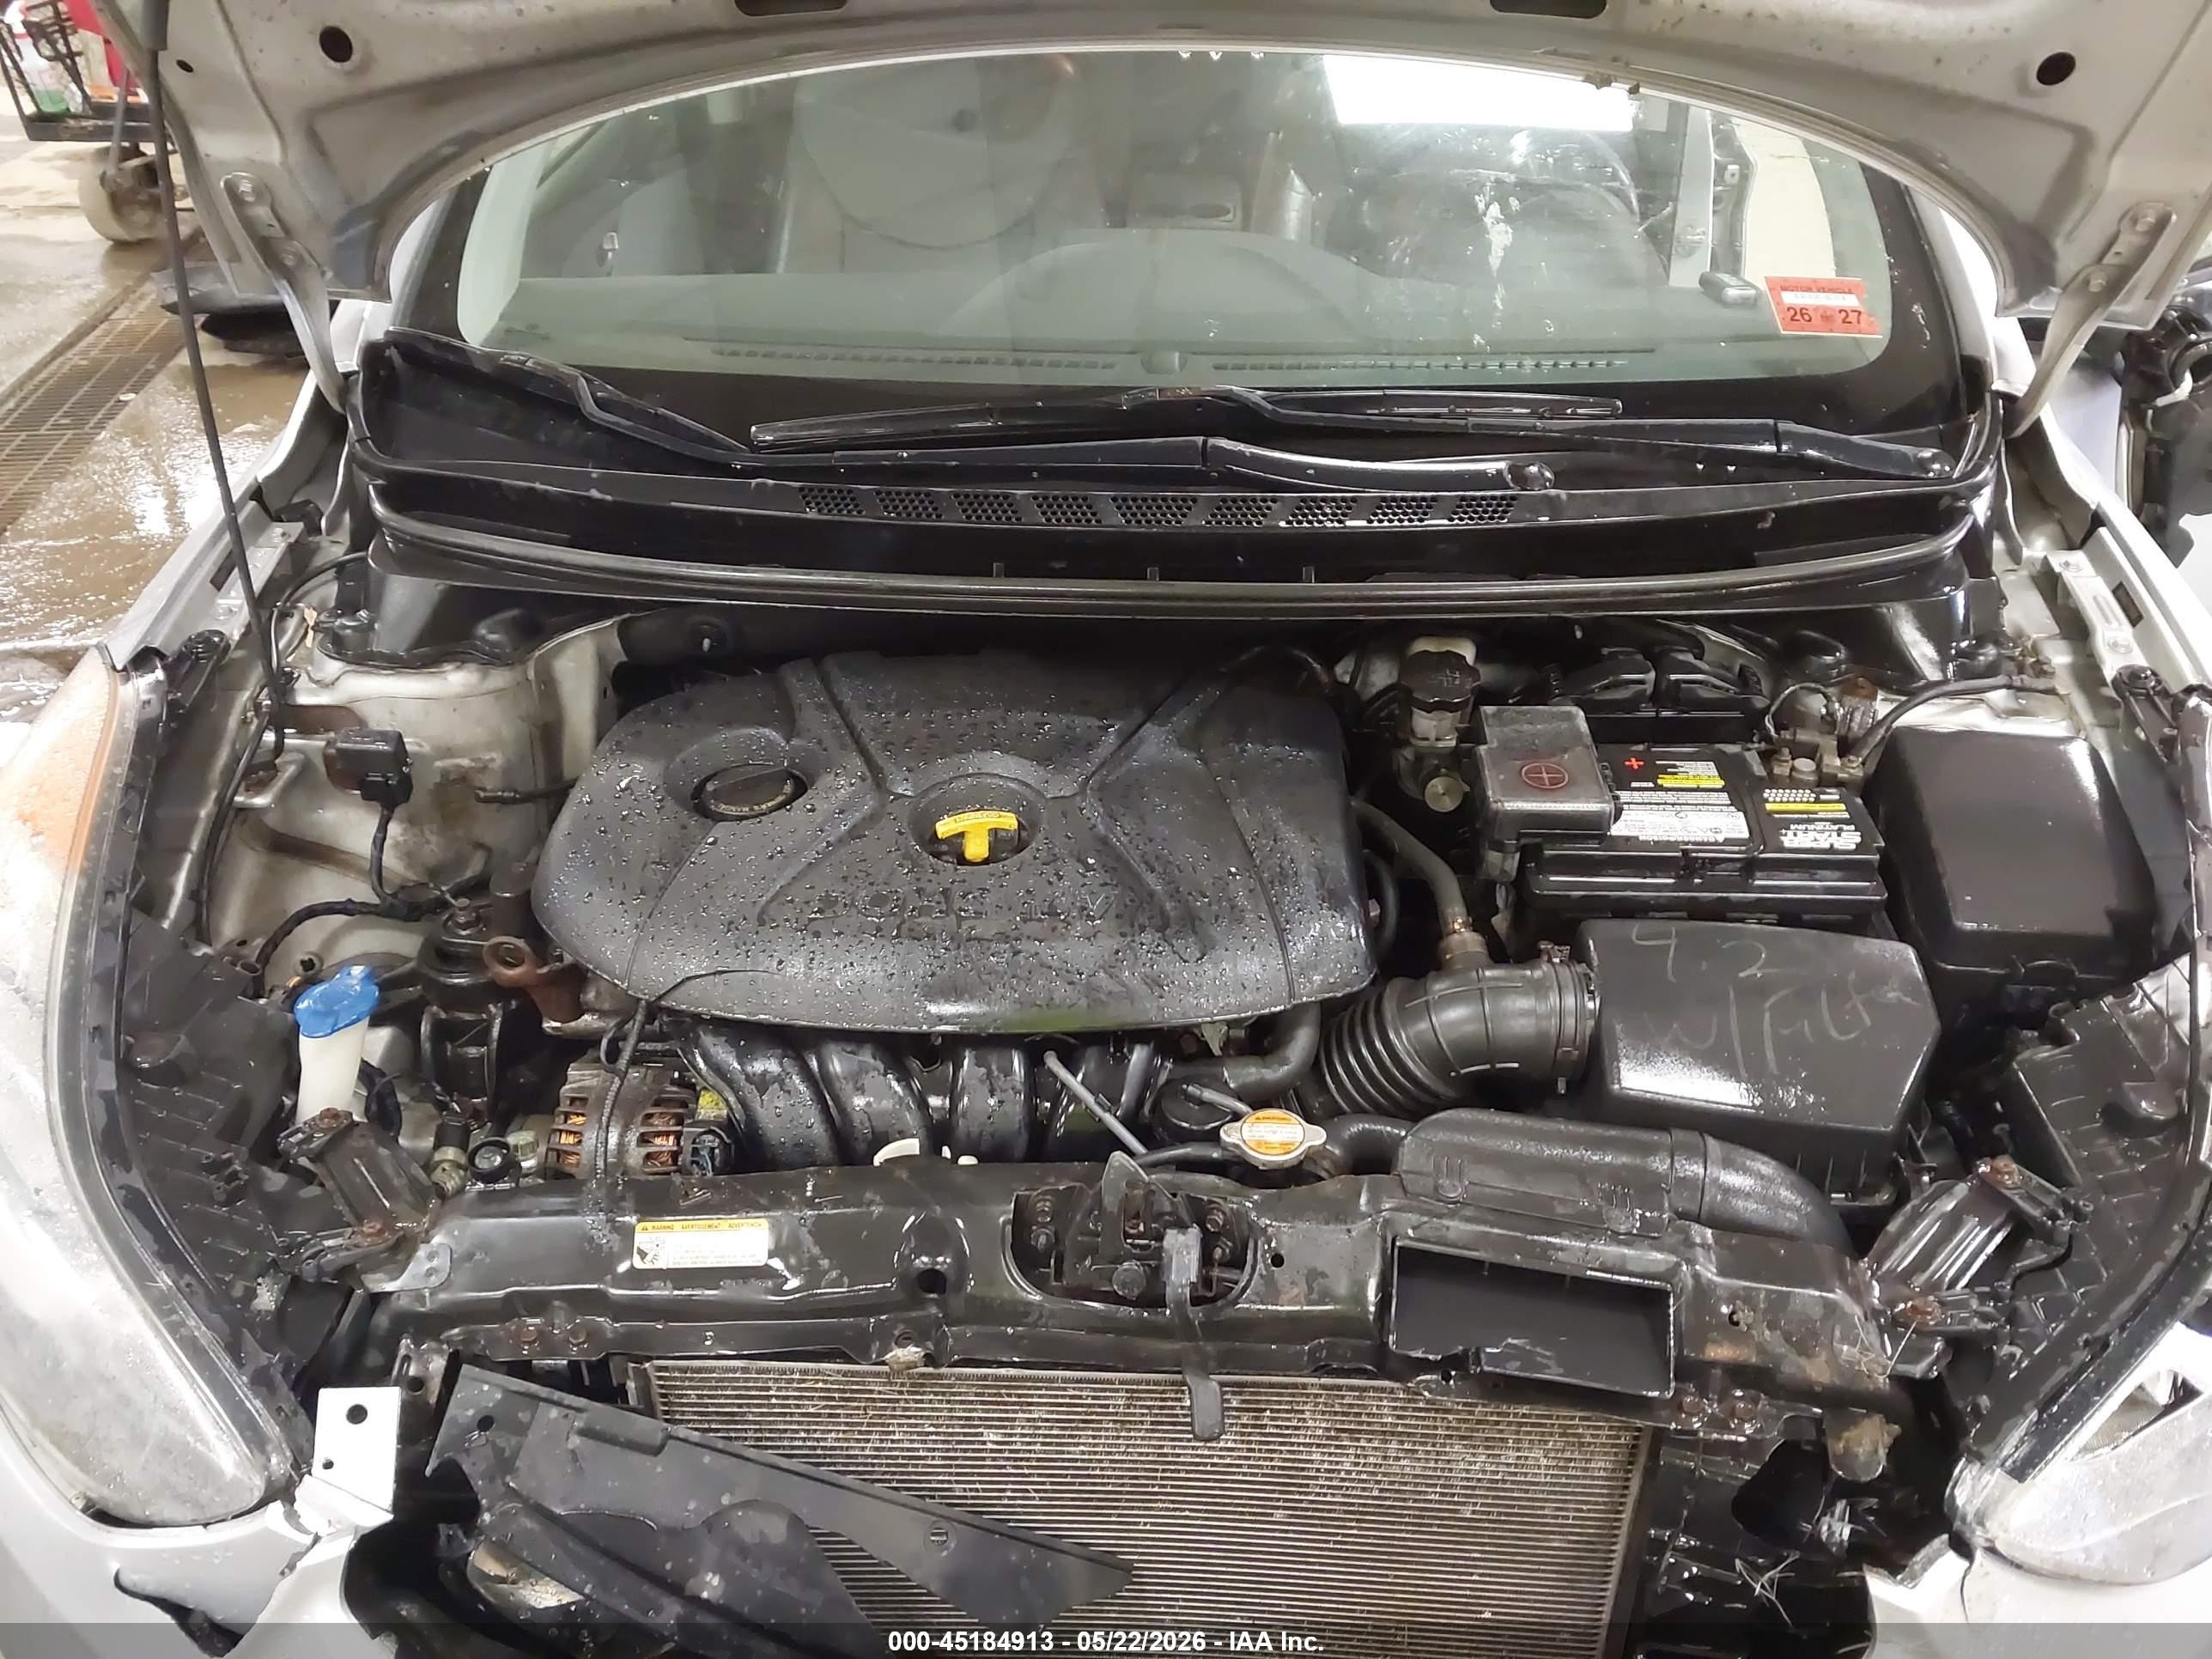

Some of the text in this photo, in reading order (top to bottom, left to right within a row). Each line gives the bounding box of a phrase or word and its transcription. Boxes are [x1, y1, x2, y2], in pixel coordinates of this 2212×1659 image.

[1786, 307, 1863, 325] 26 27
[1786, 830, 1862, 843] START
